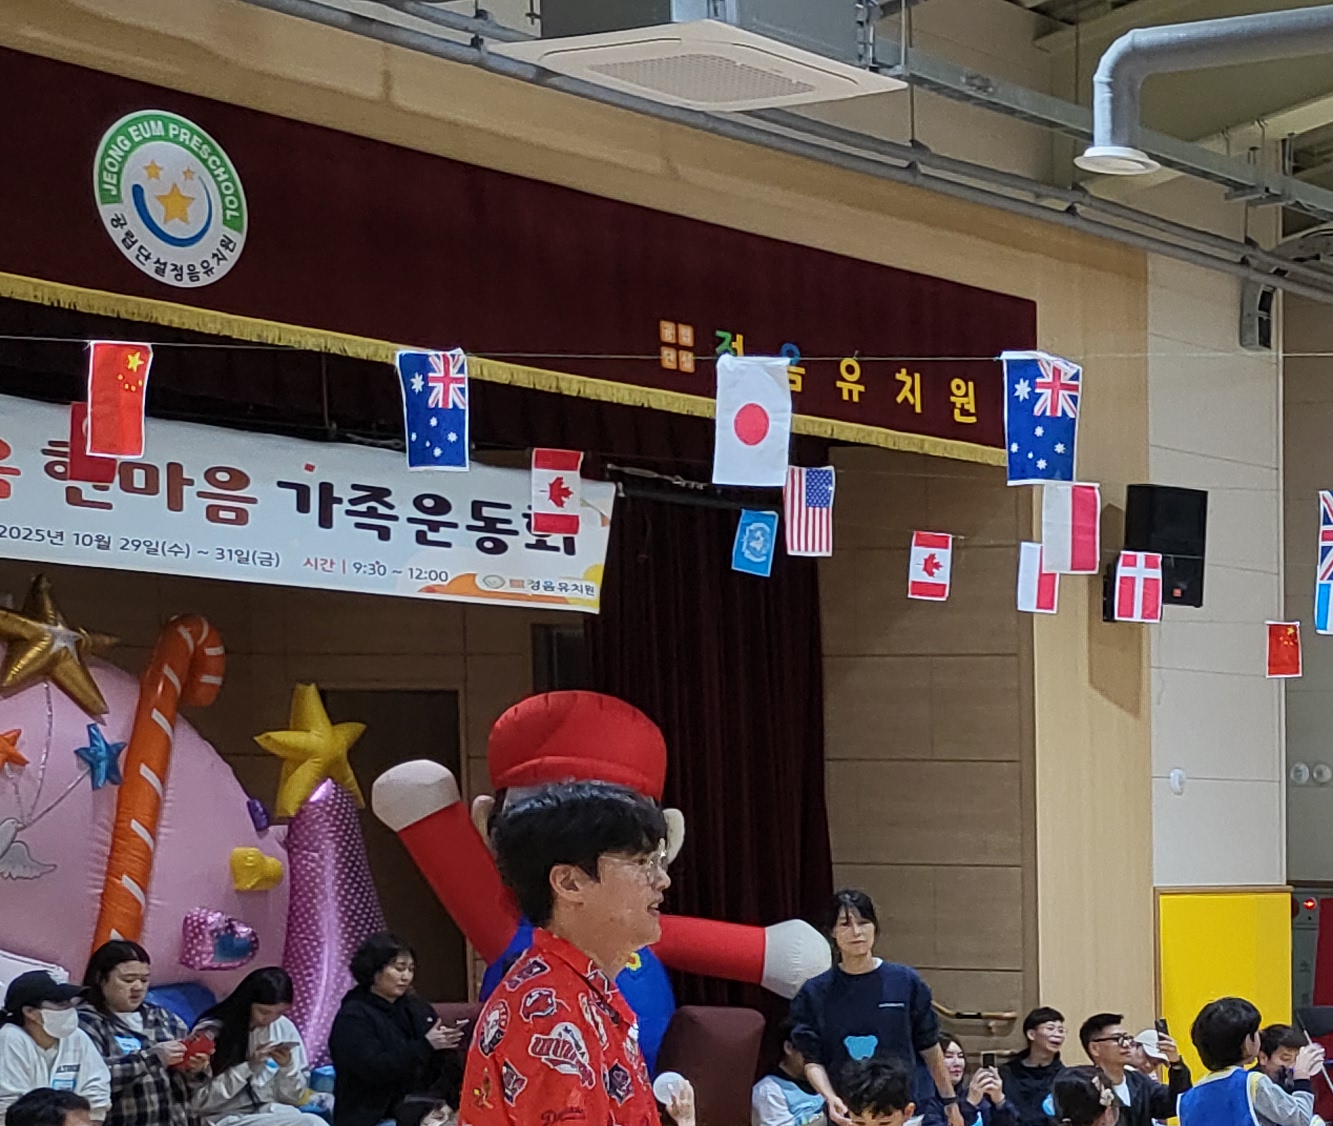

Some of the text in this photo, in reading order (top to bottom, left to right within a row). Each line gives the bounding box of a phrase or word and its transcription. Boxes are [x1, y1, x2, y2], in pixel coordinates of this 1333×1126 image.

[102, 120, 240, 221] JEONG EUM PRESCHOOL
[110, 212, 237, 283] 공립단설정음유치원
[73, 532, 112, 551] 10월
[119, 537, 191, 559] 29일(수)
[215, 547, 280, 568] 31일(금)
[303, 557, 336, 573] 시간
[352, 562, 387, 577] 9:30
[408, 567, 449, 582] 12:00
